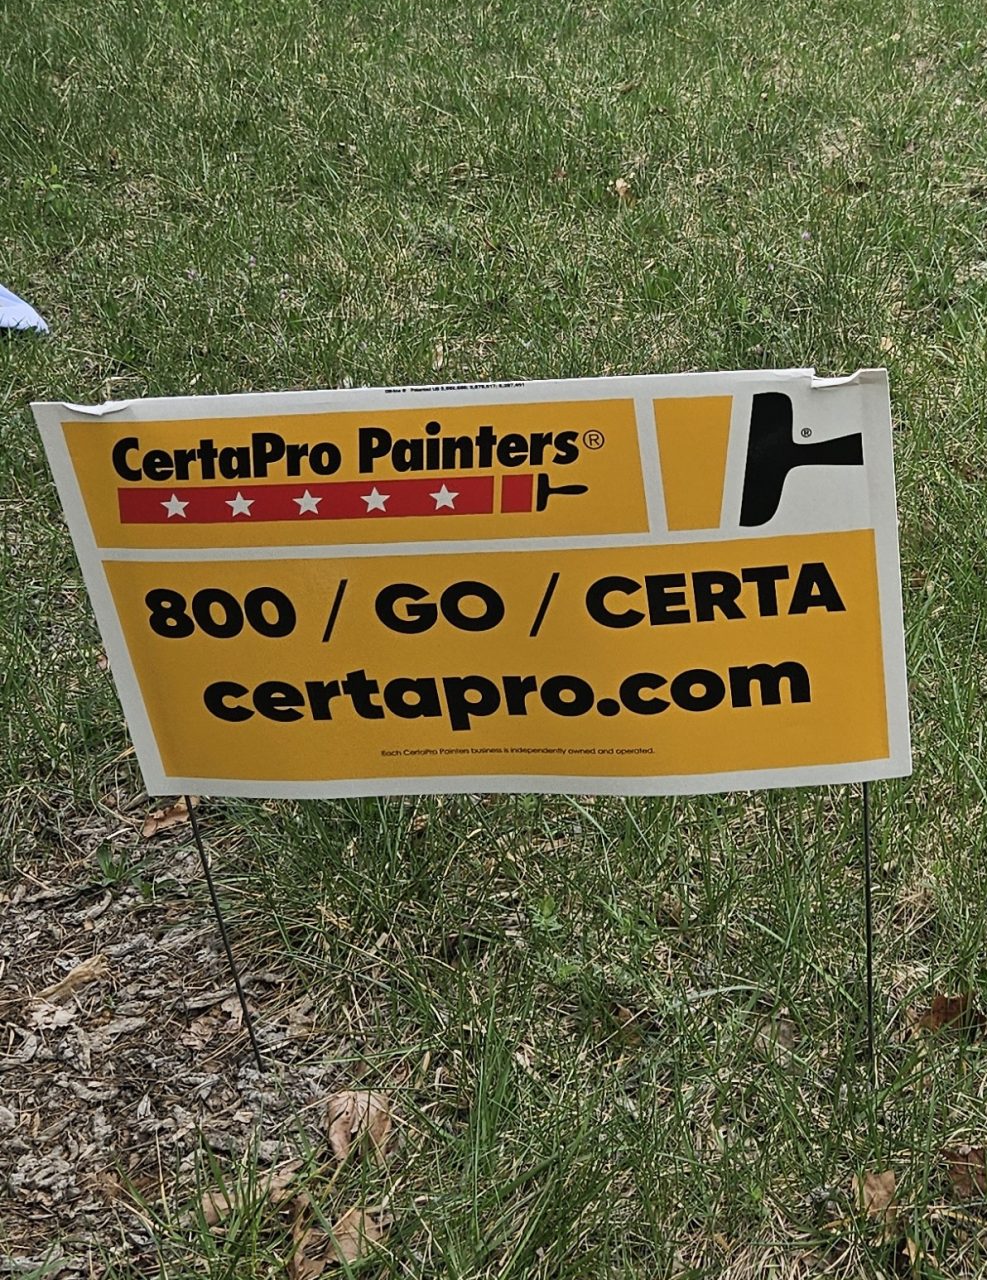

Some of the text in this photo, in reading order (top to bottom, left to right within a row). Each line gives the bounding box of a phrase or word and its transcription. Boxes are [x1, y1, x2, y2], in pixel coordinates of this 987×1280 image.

[112, 433, 342, 482] CertaPro
[145, 586, 297, 639] 800
[375, 580, 506, 635] GO
[586, 562, 847, 629] CERTA
[203, 661, 812, 732] certapro.com
[403, 748, 438, 756] CertaPro
[439, 747, 470, 756] Painters
[511, 747, 567, 755] independently
[568, 747, 596, 755] owned
[598, 747, 614, 755] and
